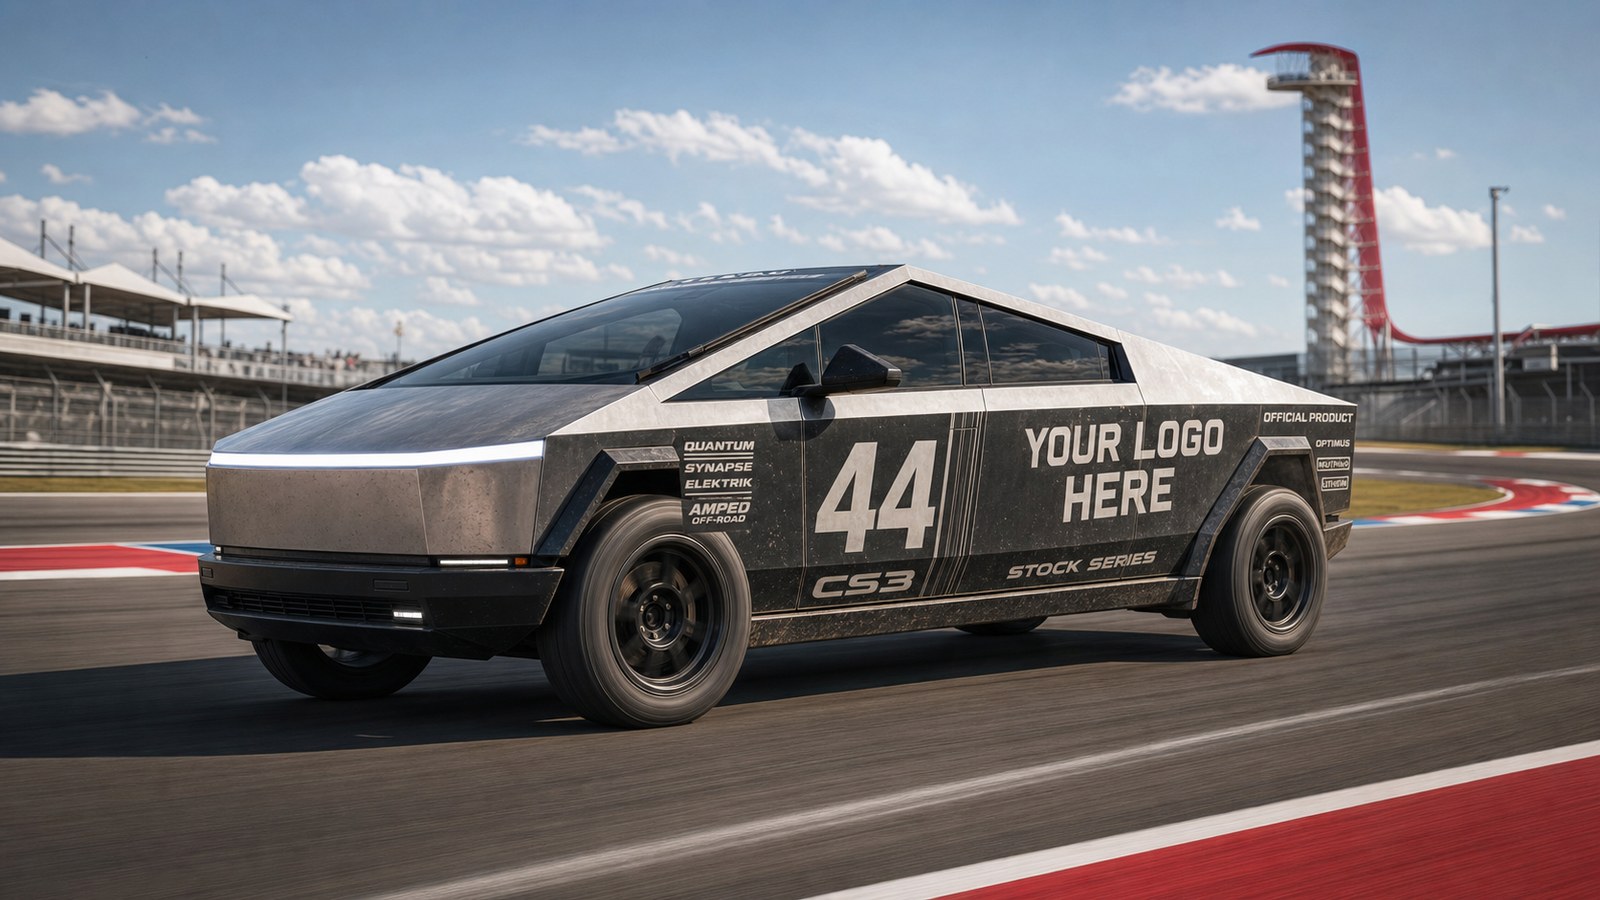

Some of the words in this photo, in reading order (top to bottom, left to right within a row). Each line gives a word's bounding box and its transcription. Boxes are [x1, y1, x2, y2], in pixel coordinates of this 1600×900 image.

[1263, 412, 1308, 423] OFFICIAL
[1309, 412, 1354, 423] PRODUCT
[684, 441, 755, 452] QUANTUM
[1025, 423, 1122, 468] YOUR
[1133, 418, 1225, 460] LOGO
[1315, 439, 1351, 448] OPTIMUS
[684, 462, 753, 473] SYNAPSE
[685, 478, 753, 489] ELEKTRIK
[815, 440, 937, 553] 44
[1062, 467, 1175, 523] HERE
[688, 501, 751, 516] AMPED
[691, 515, 746, 525] OFF-ROAD
[1006, 559, 1083, 579] STOCK
[1087, 551, 1158, 571] SERIES
[812, 569, 915, 599] CS3
